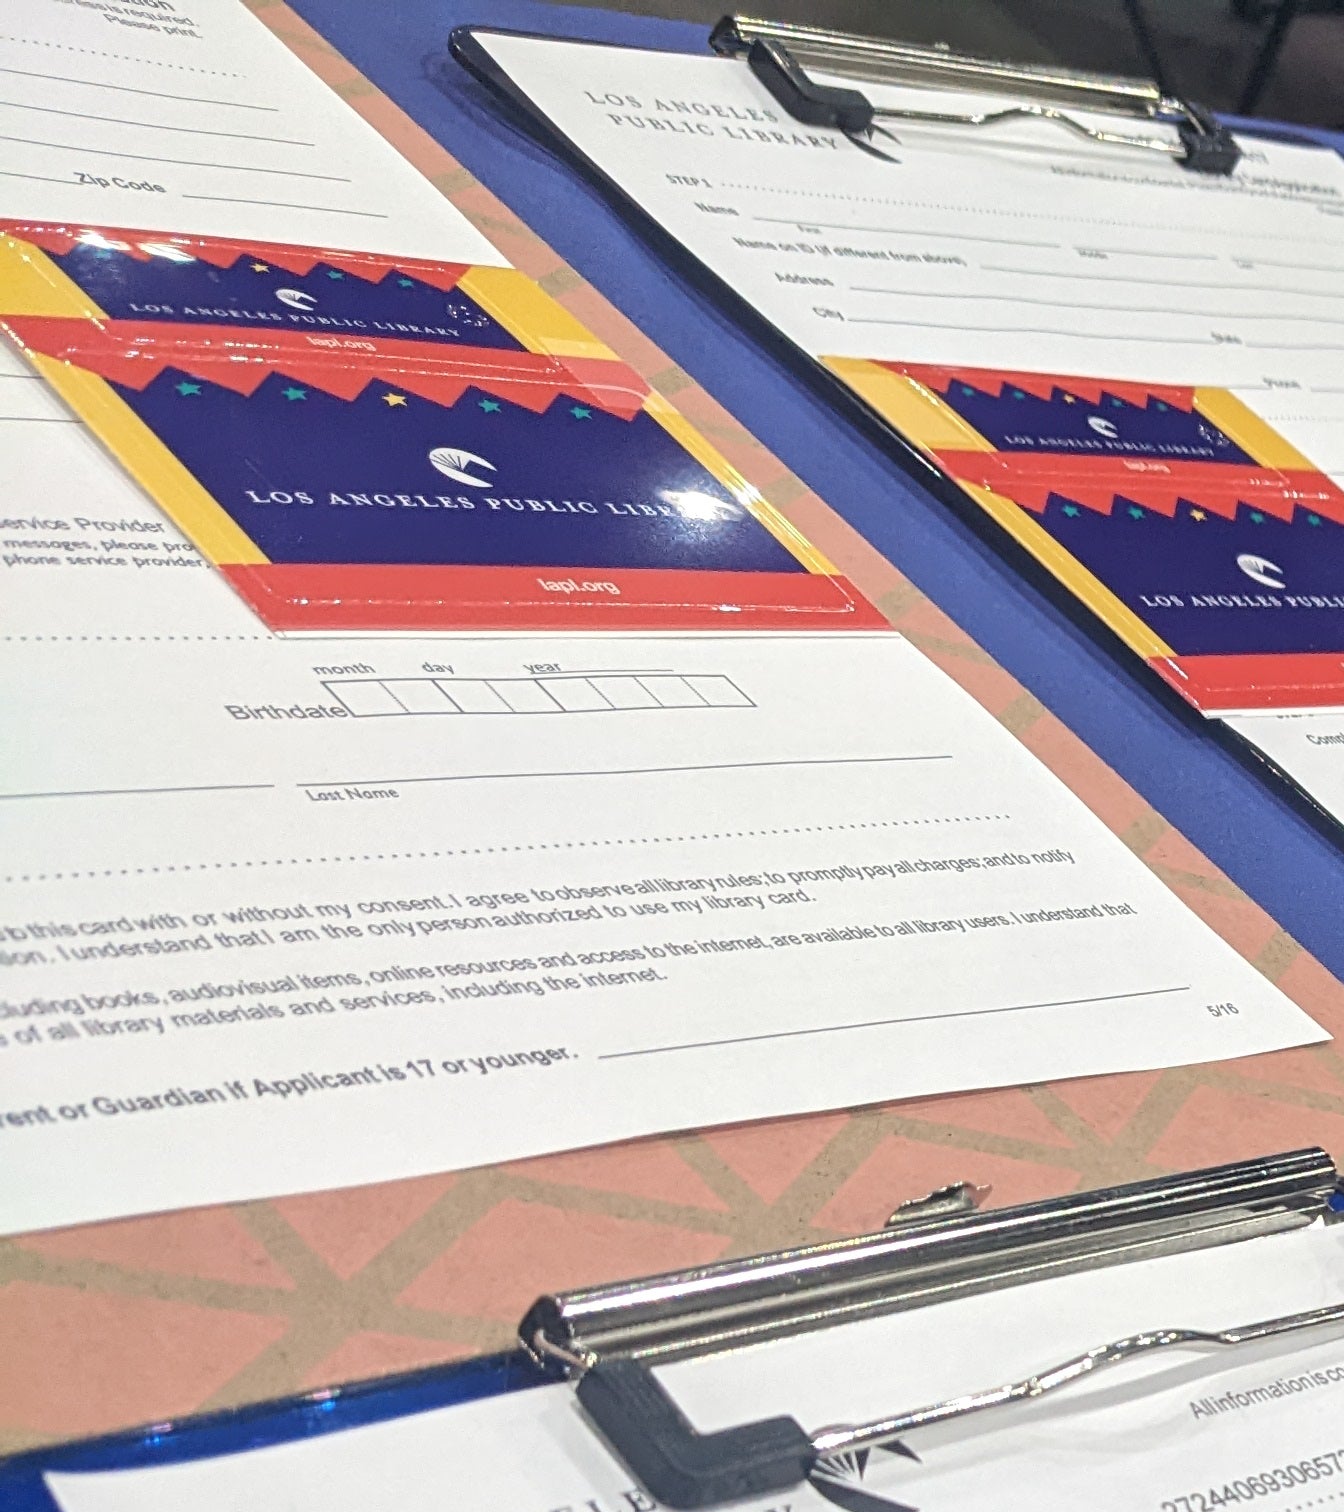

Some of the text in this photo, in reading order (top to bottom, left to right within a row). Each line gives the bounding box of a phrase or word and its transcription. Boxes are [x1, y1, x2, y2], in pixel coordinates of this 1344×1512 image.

[584, 90, 778, 123] LOS ANGELES
[606, 113, 838, 150] PUBLIC LIBRARY
[74, 171, 166, 193] Zip Code
[130, 303, 460, 337] LOS ANGELES PUBLIC LIBRARY
[306, 337, 376, 351] lapl.org
[245, 489, 315, 505] LOS
[328, 493, 475, 510] ANGELES
[483, 498, 598, 514] PUBLIC
[73, 517, 165, 534] Provider
[536, 578, 621, 595] lapl.org
[1140, 595, 1185, 608] LOS
[1191, 595, 1282, 608] ANGELES
[312, 661, 562, 675] month day year
[224, 704, 350, 720] Birthdate
[304, 786, 399, 802] Last Name
[1206, 1001, 1239, 1018] 5/16
[60, 1044, 581, 1121] or Guardian if Applicant is 17 or younger.
[1189, 1399, 1212, 1419] All
[1211, 1372, 1311, 1412] information
[1307, 1372, 1328, 1387] is
